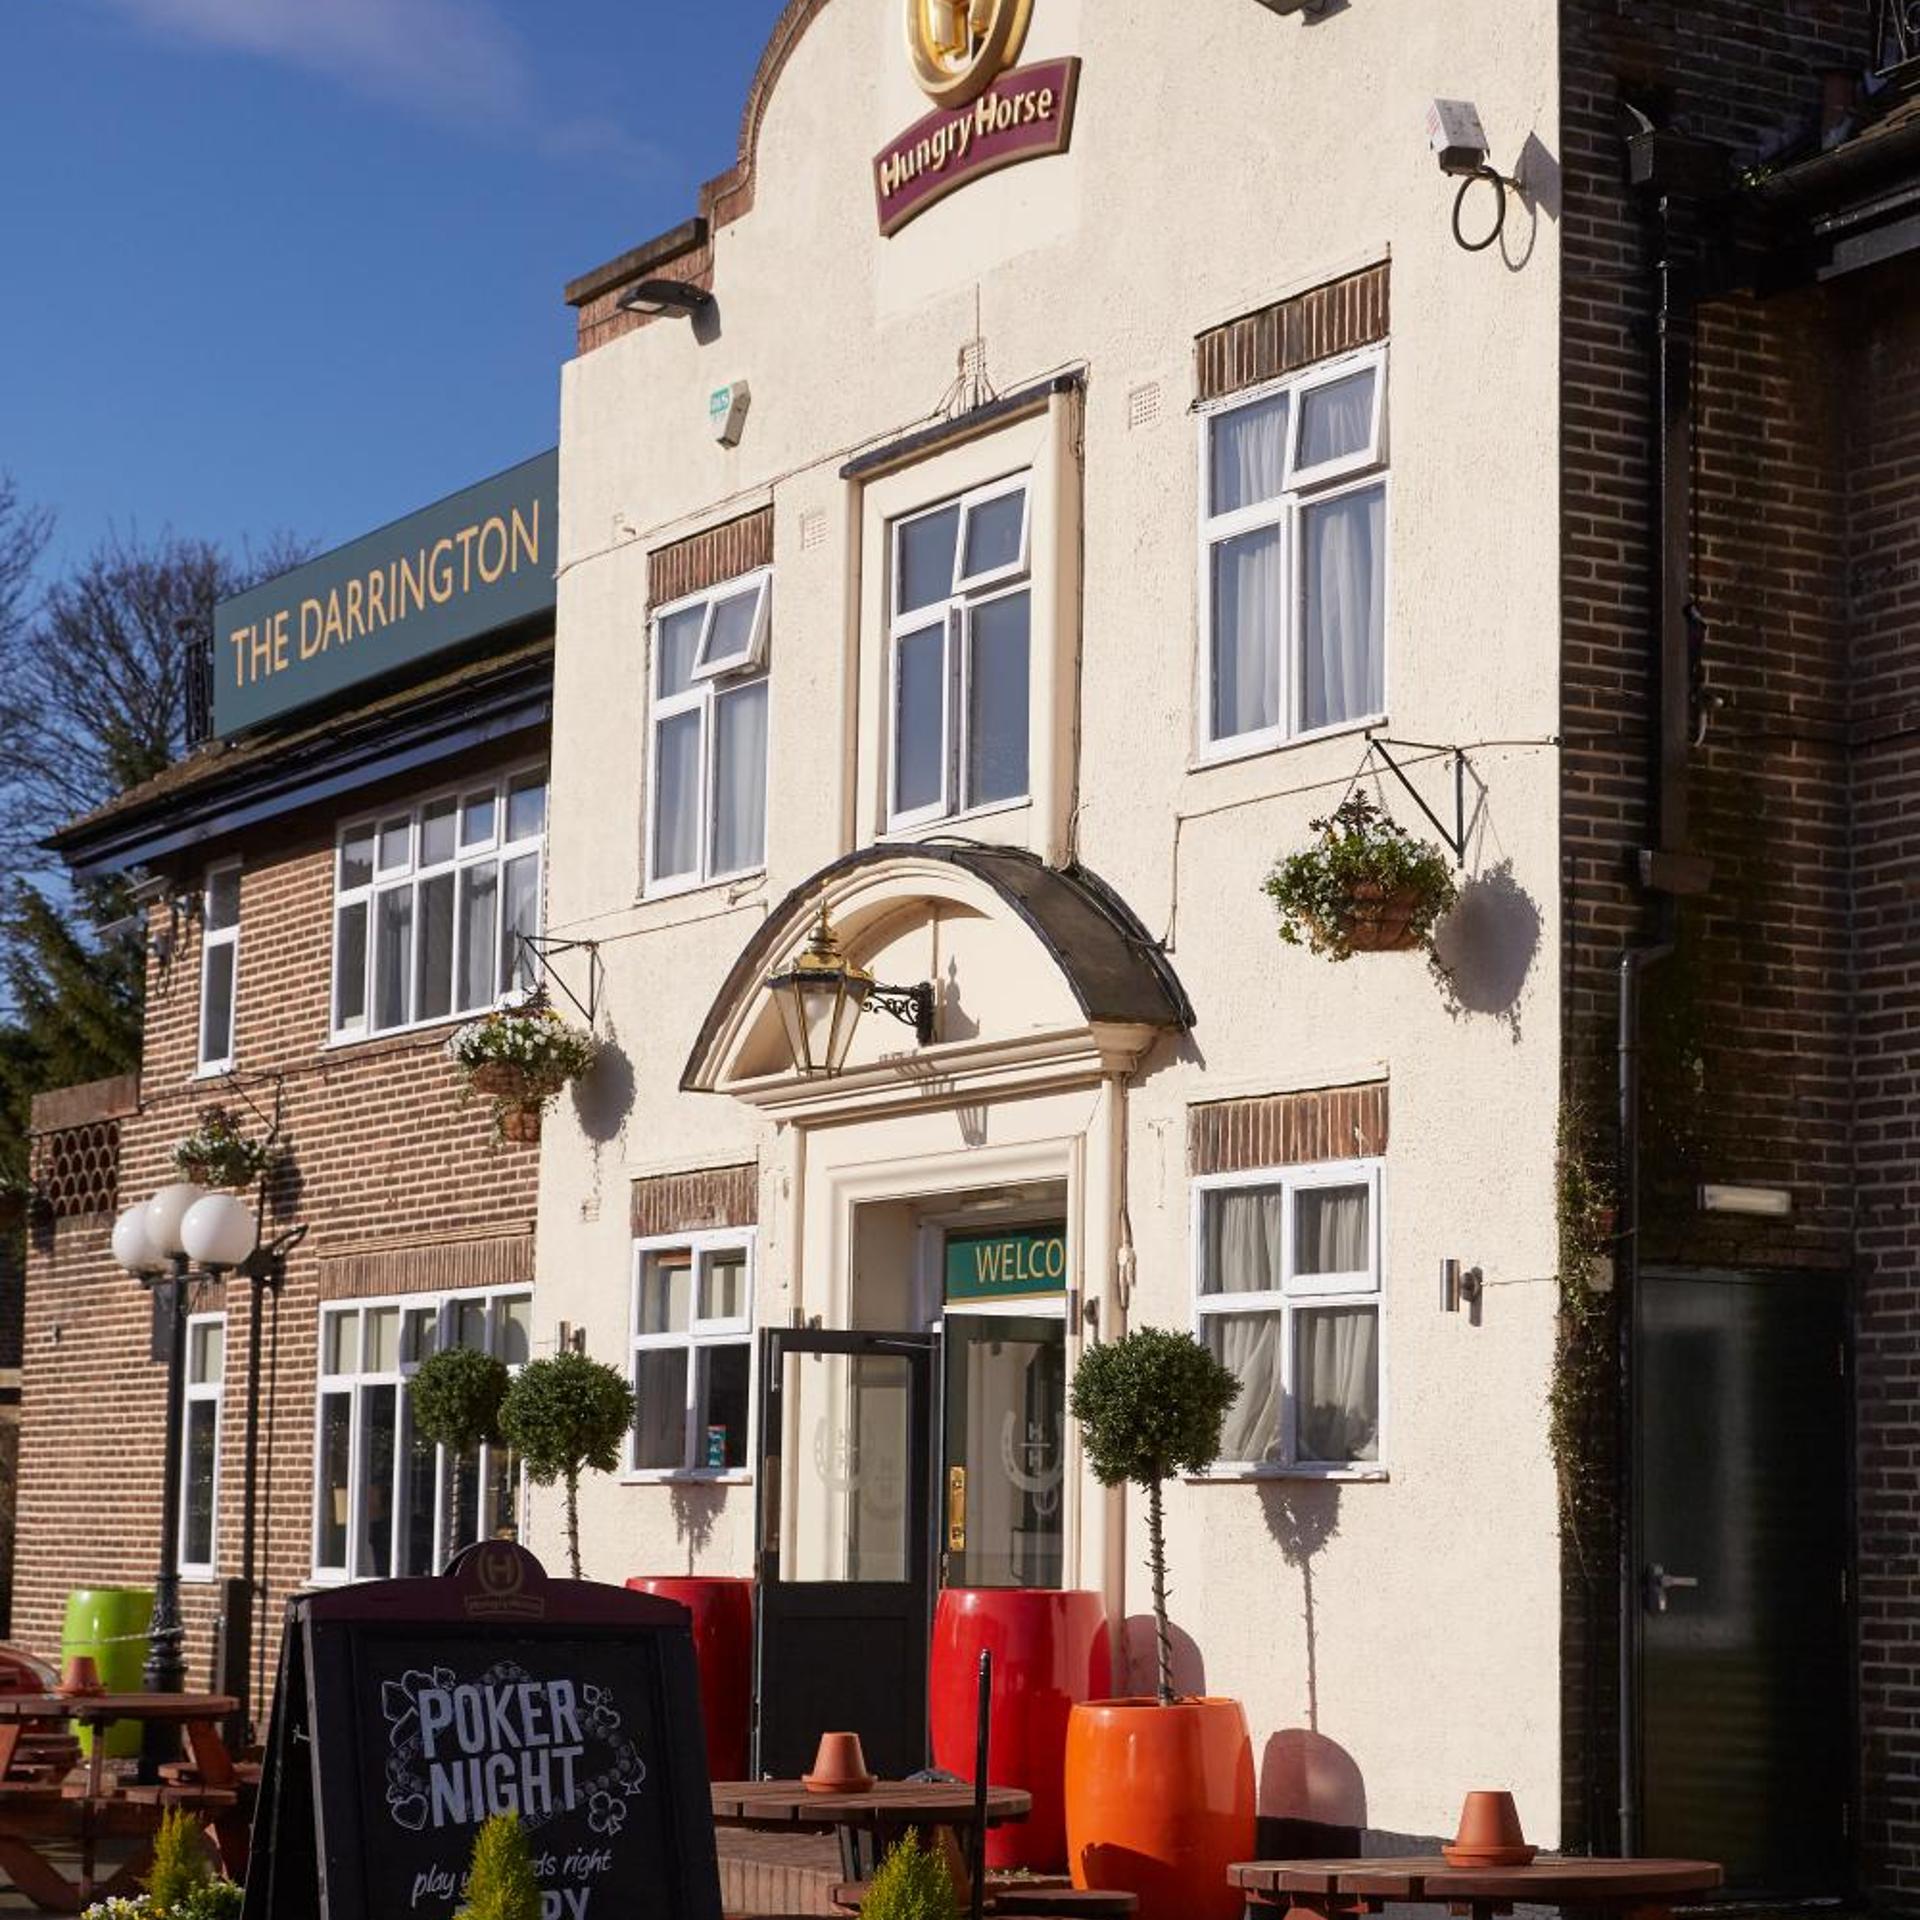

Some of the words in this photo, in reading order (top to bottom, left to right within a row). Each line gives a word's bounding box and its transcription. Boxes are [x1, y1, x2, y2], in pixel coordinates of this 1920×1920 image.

[881, 113, 973, 195] Hungry
[975, 88, 1052, 135] Horse
[231, 611, 289, 686] THE
[300, 500, 538, 660] DARRINGTON
[418, 1679, 584, 1759] POKER
[429, 1747, 584, 1827] NIGHT
[412, 1862, 456, 1908] play
[564, 1847, 611, 1880] right
